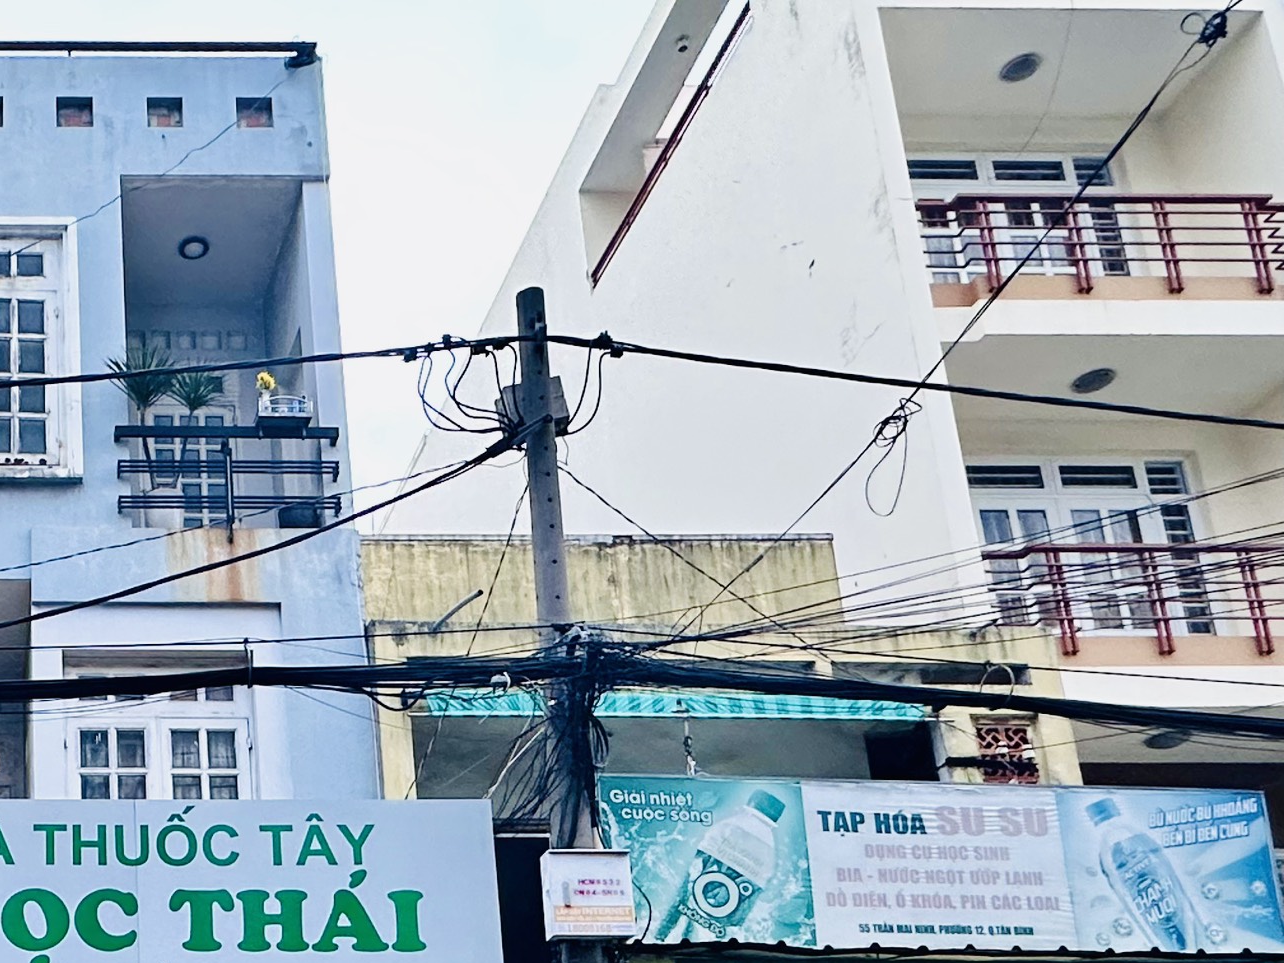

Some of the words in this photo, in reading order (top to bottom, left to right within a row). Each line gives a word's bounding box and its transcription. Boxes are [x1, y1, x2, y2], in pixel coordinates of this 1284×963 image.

[33, 805, 240, 867] THUỐC
[259, 813, 375, 867] TÂY
[816, 810, 865, 837] TẠP
[873, 809, 927, 834] HÓA
[935, 806, 985, 836] SU
[997, 807, 1048, 837] SU
[836, 868, 863, 882] BIA
[169, 869, 427, 953] THÁI
[960, 895, 986, 910] PIN
